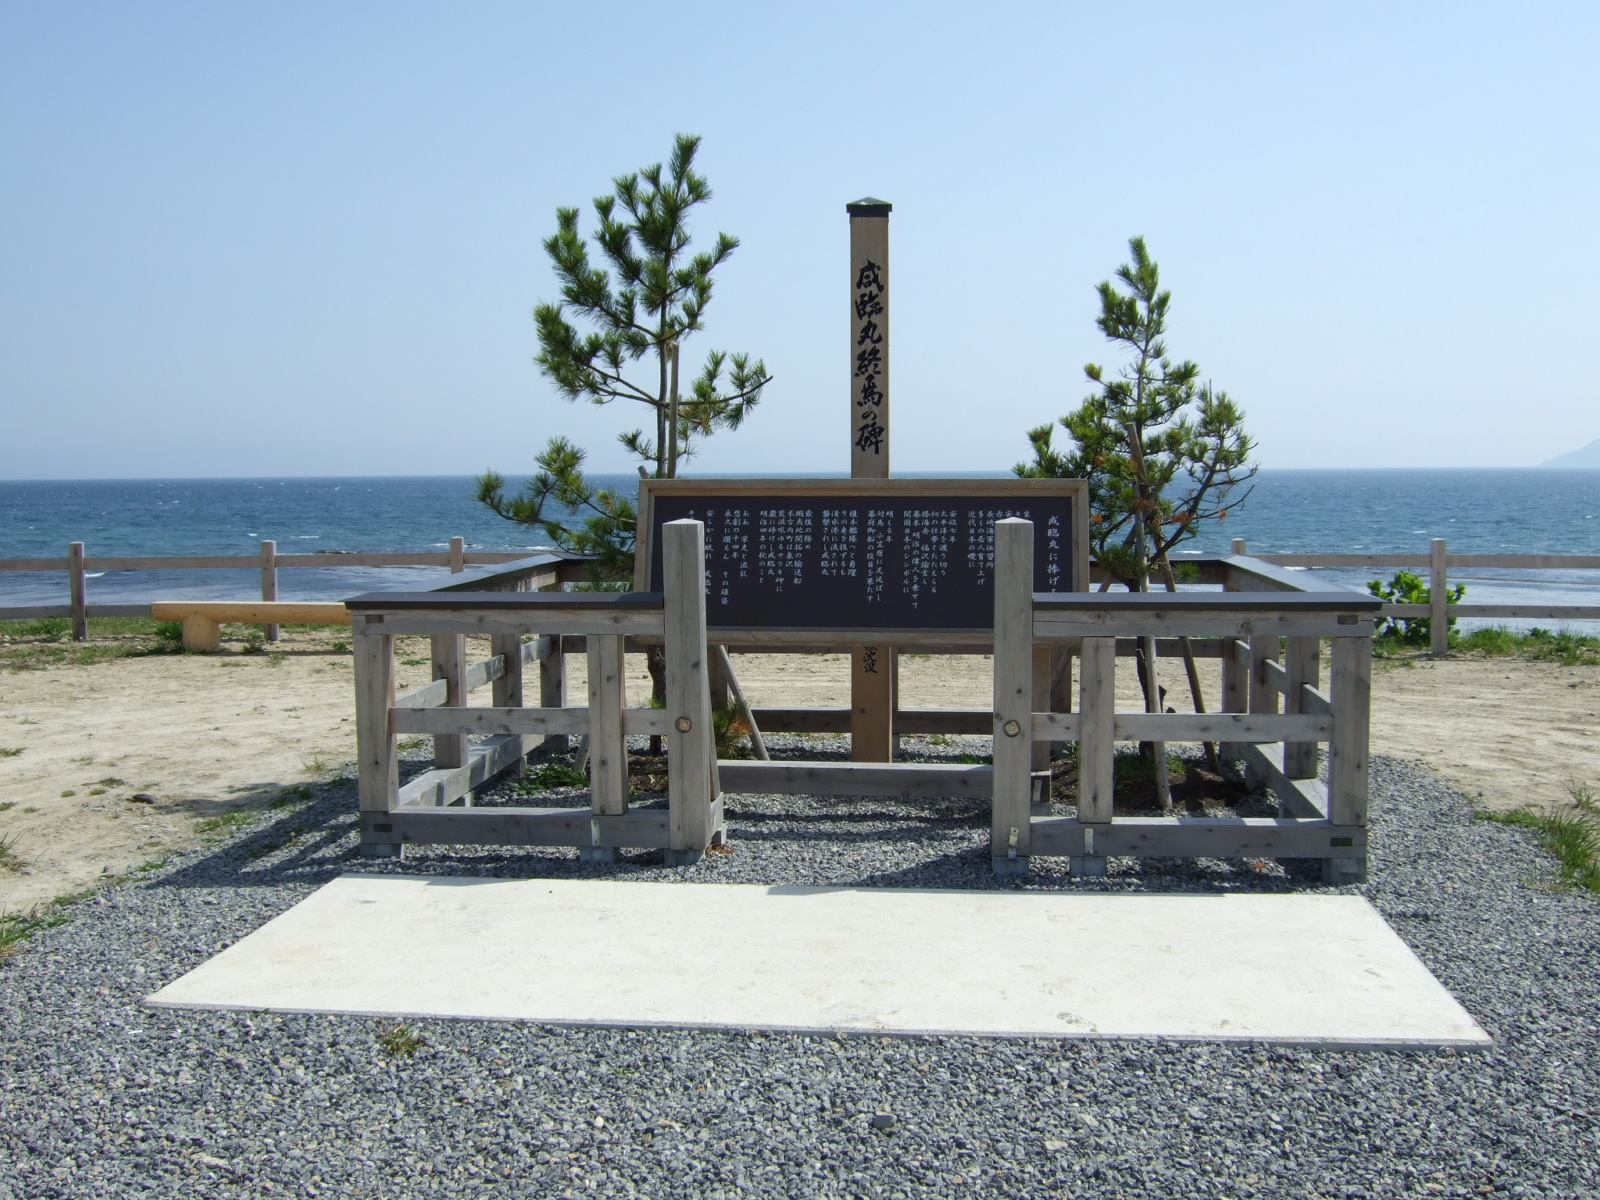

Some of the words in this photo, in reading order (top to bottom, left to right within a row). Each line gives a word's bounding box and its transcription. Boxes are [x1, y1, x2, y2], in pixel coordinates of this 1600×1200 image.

[855, 259, 884, 455] 咸臨丸終焉の碑
[921, 510, 931, 535] 勝海舟
